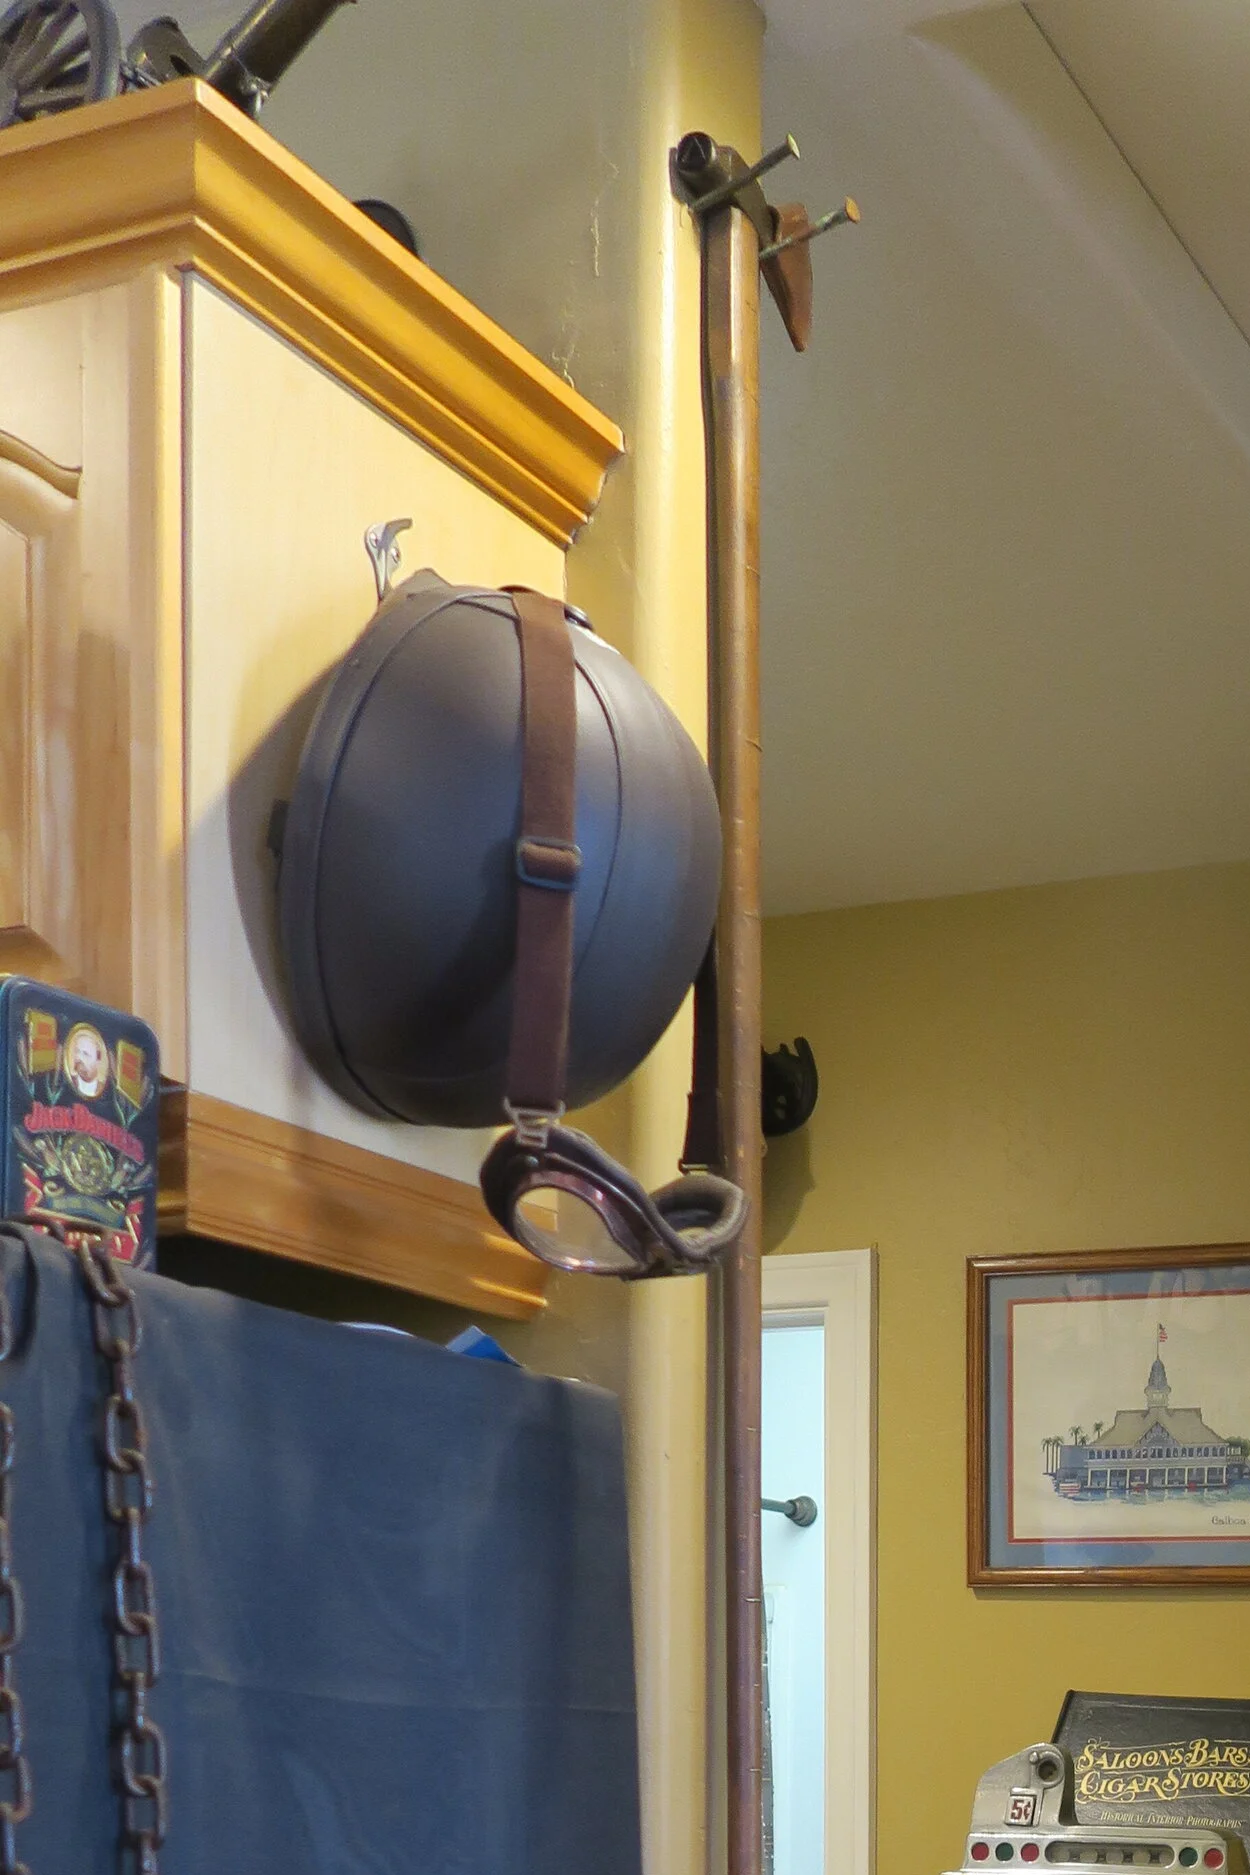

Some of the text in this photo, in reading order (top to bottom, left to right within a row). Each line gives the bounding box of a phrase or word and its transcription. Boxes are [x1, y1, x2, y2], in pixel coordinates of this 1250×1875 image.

[1078, 1770, 1170, 1801] CIGAR
[1010, 1799, 1033, 1821] 5¢
[1146, 1813, 1184, 1826] INTERIOR
